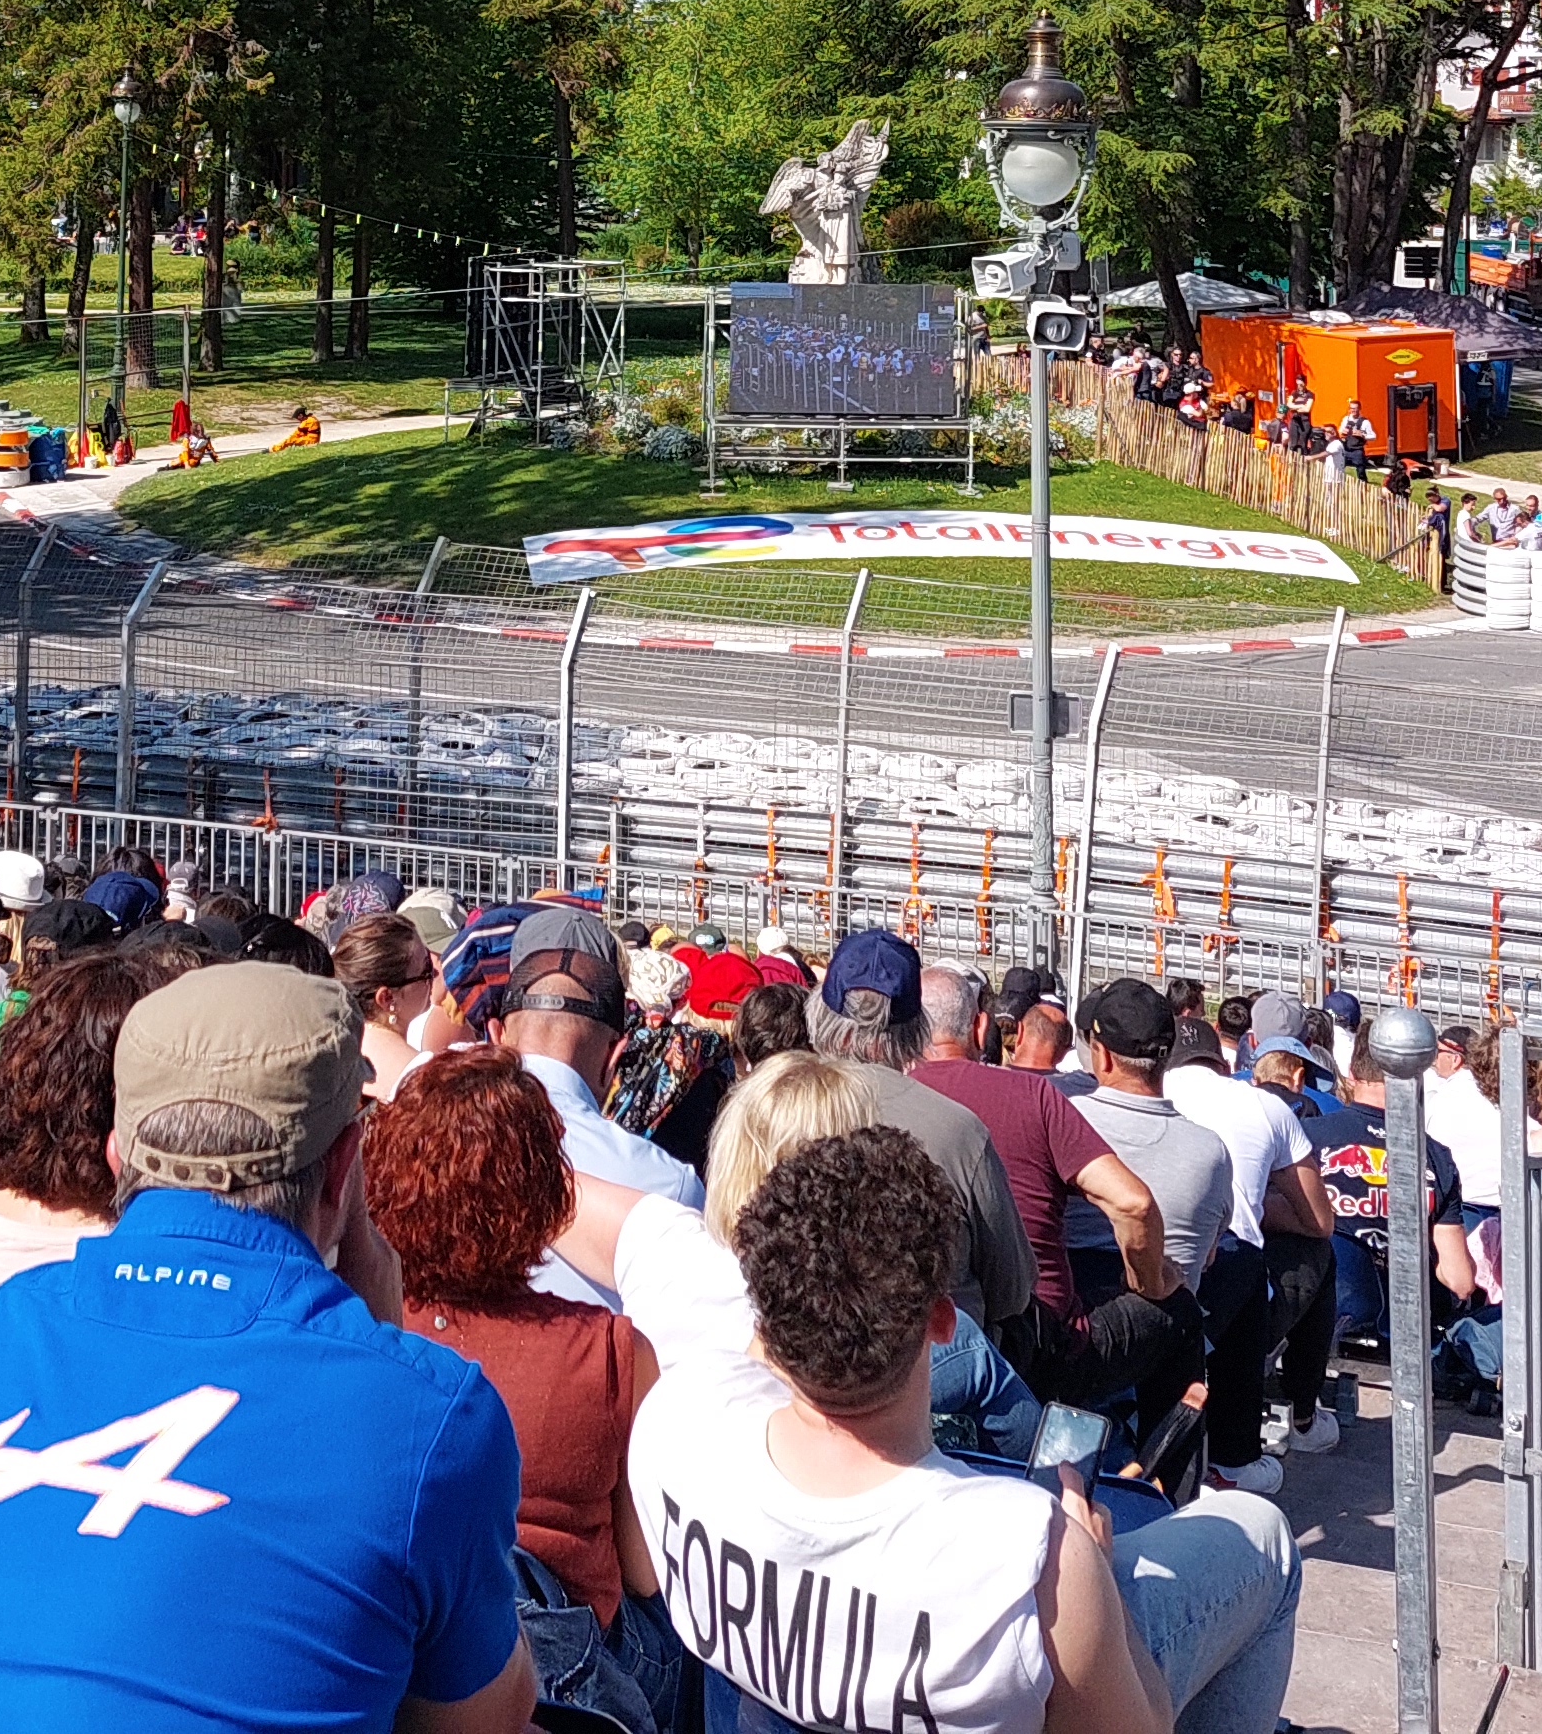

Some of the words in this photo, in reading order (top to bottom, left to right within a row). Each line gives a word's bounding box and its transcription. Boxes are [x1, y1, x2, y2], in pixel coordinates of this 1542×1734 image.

[1325, 1184, 1379, 1218] Red
[114, 1263, 232, 1291] ALPINE
[661, 1487, 940, 1734] FORMULA
